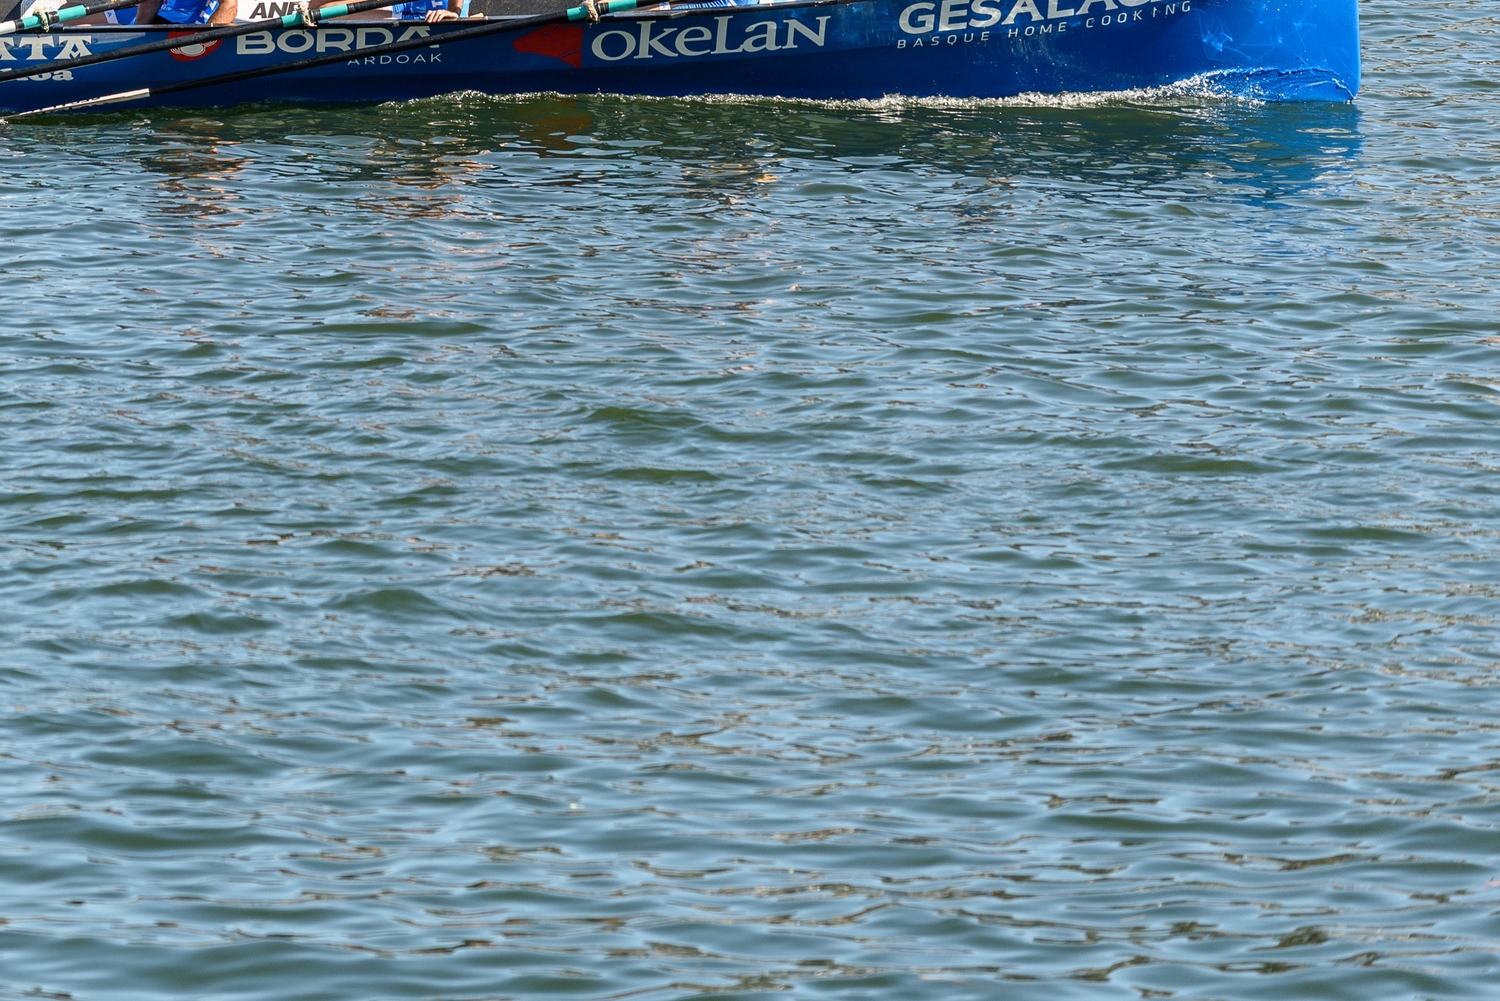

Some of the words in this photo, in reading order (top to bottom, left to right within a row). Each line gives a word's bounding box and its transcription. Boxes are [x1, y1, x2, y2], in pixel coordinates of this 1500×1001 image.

[897, 31, 990, 49] BASQUE
[1008, 22, 1067, 38] HOME
[1085, 0, 1192, 28] COOKING
